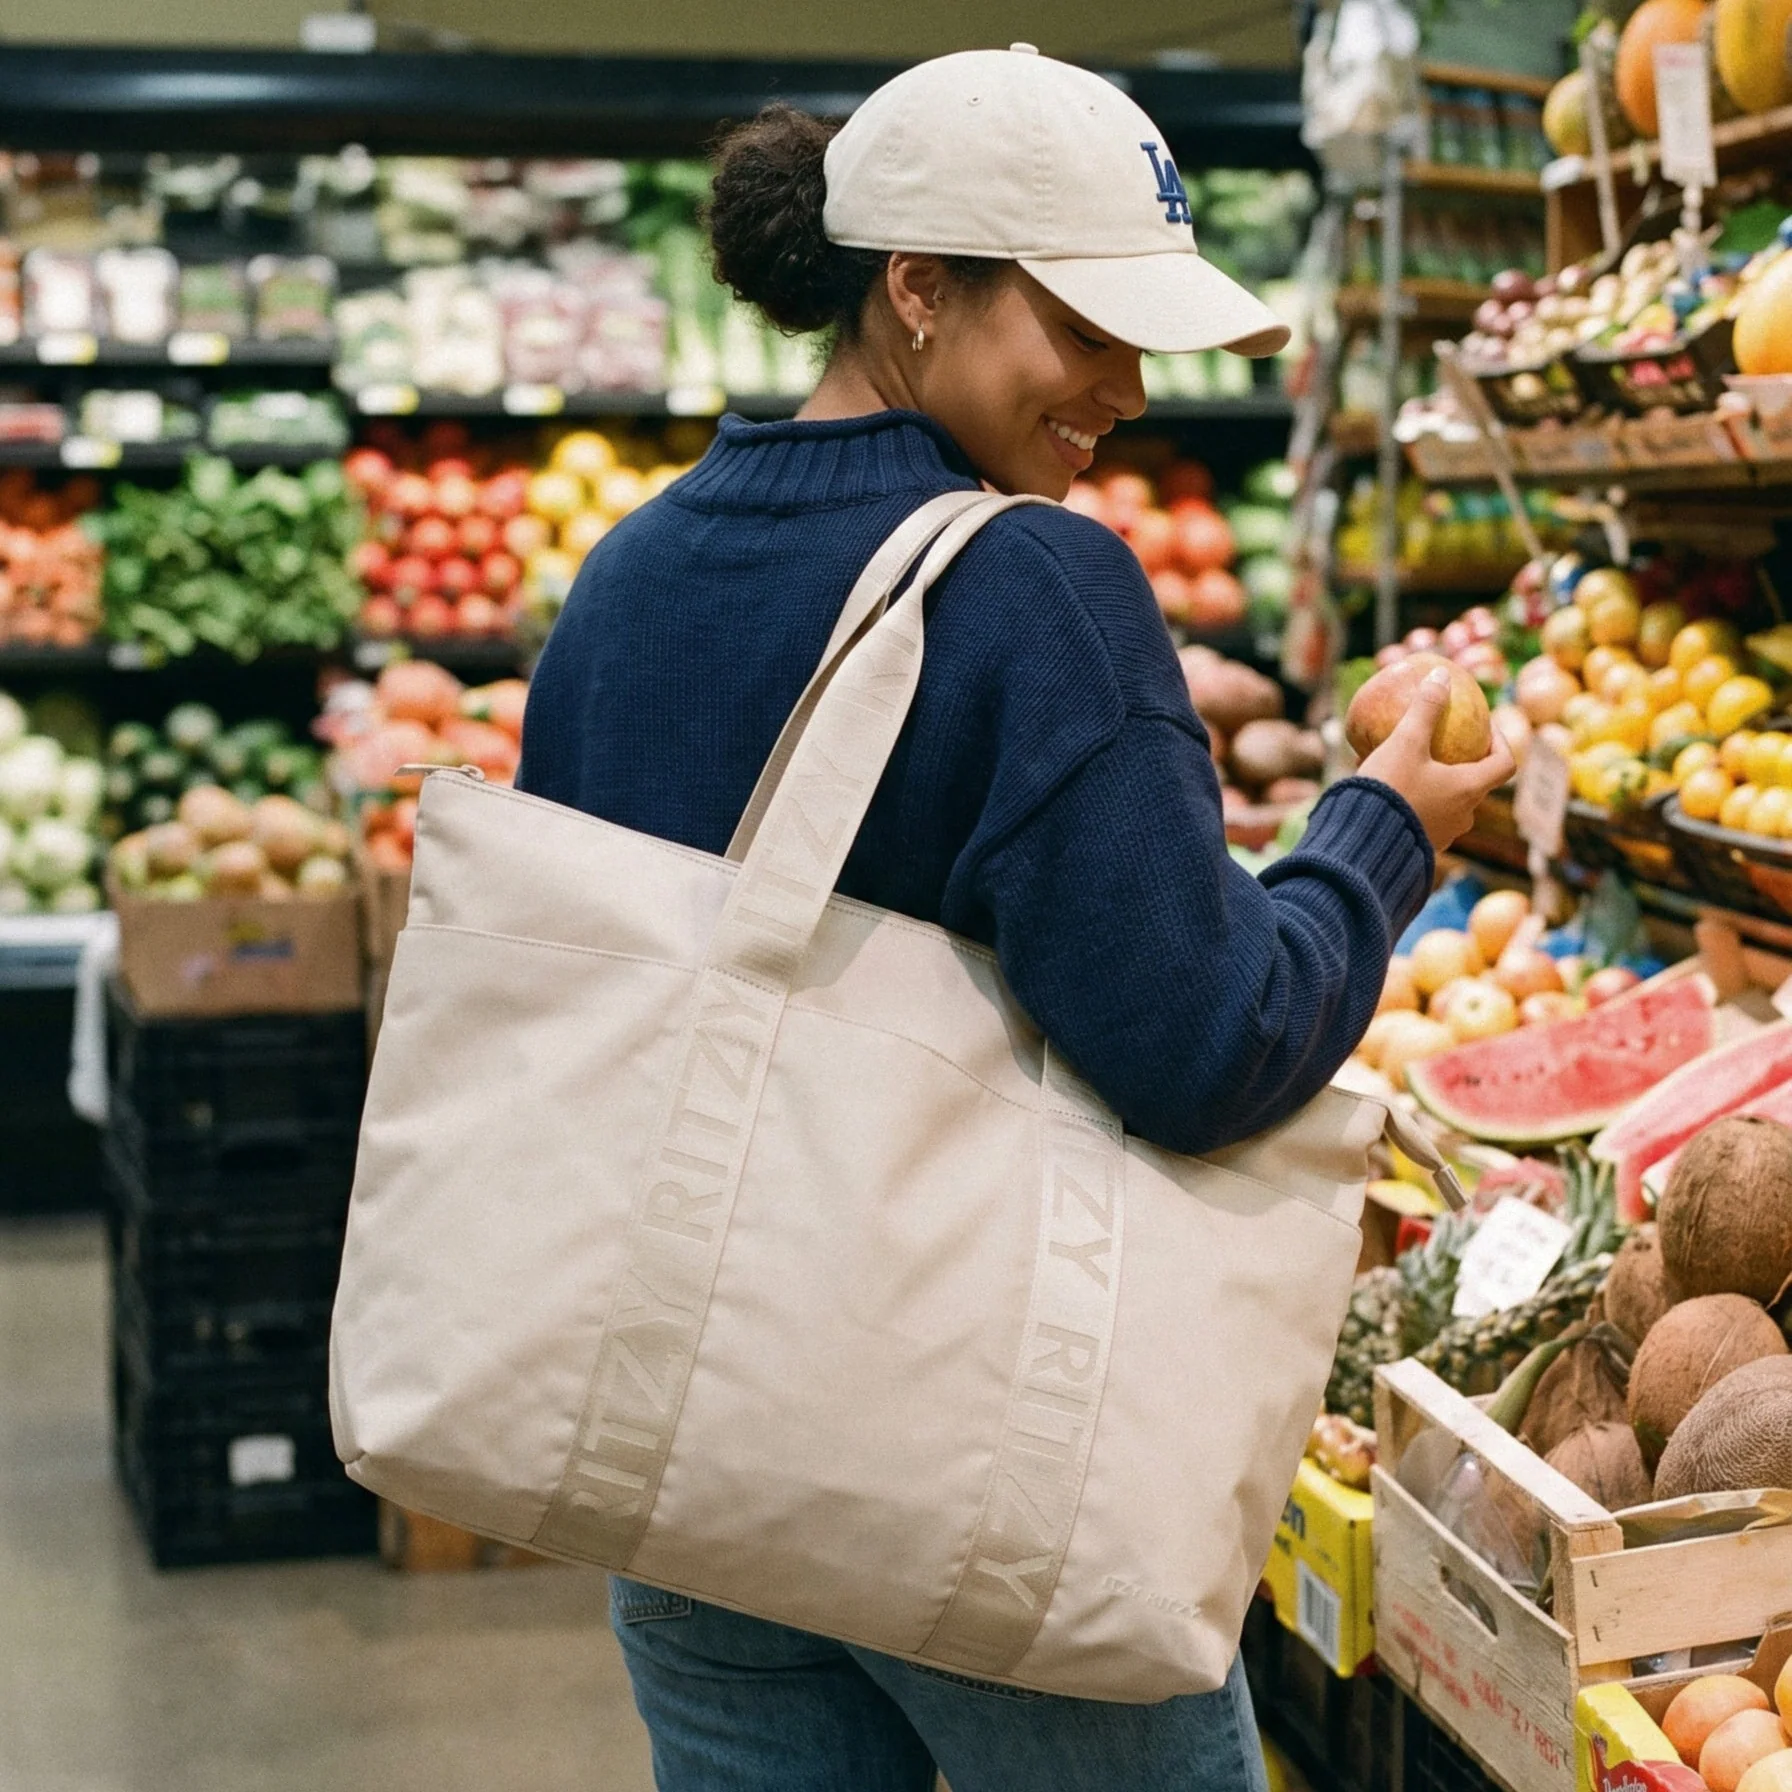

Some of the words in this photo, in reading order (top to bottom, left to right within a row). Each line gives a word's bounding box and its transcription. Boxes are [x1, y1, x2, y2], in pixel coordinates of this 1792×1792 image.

[1140, 141, 1193, 225] LA
[640, 983, 770, 1243] RITZY
[974, 1320, 1101, 1610] RITZY
